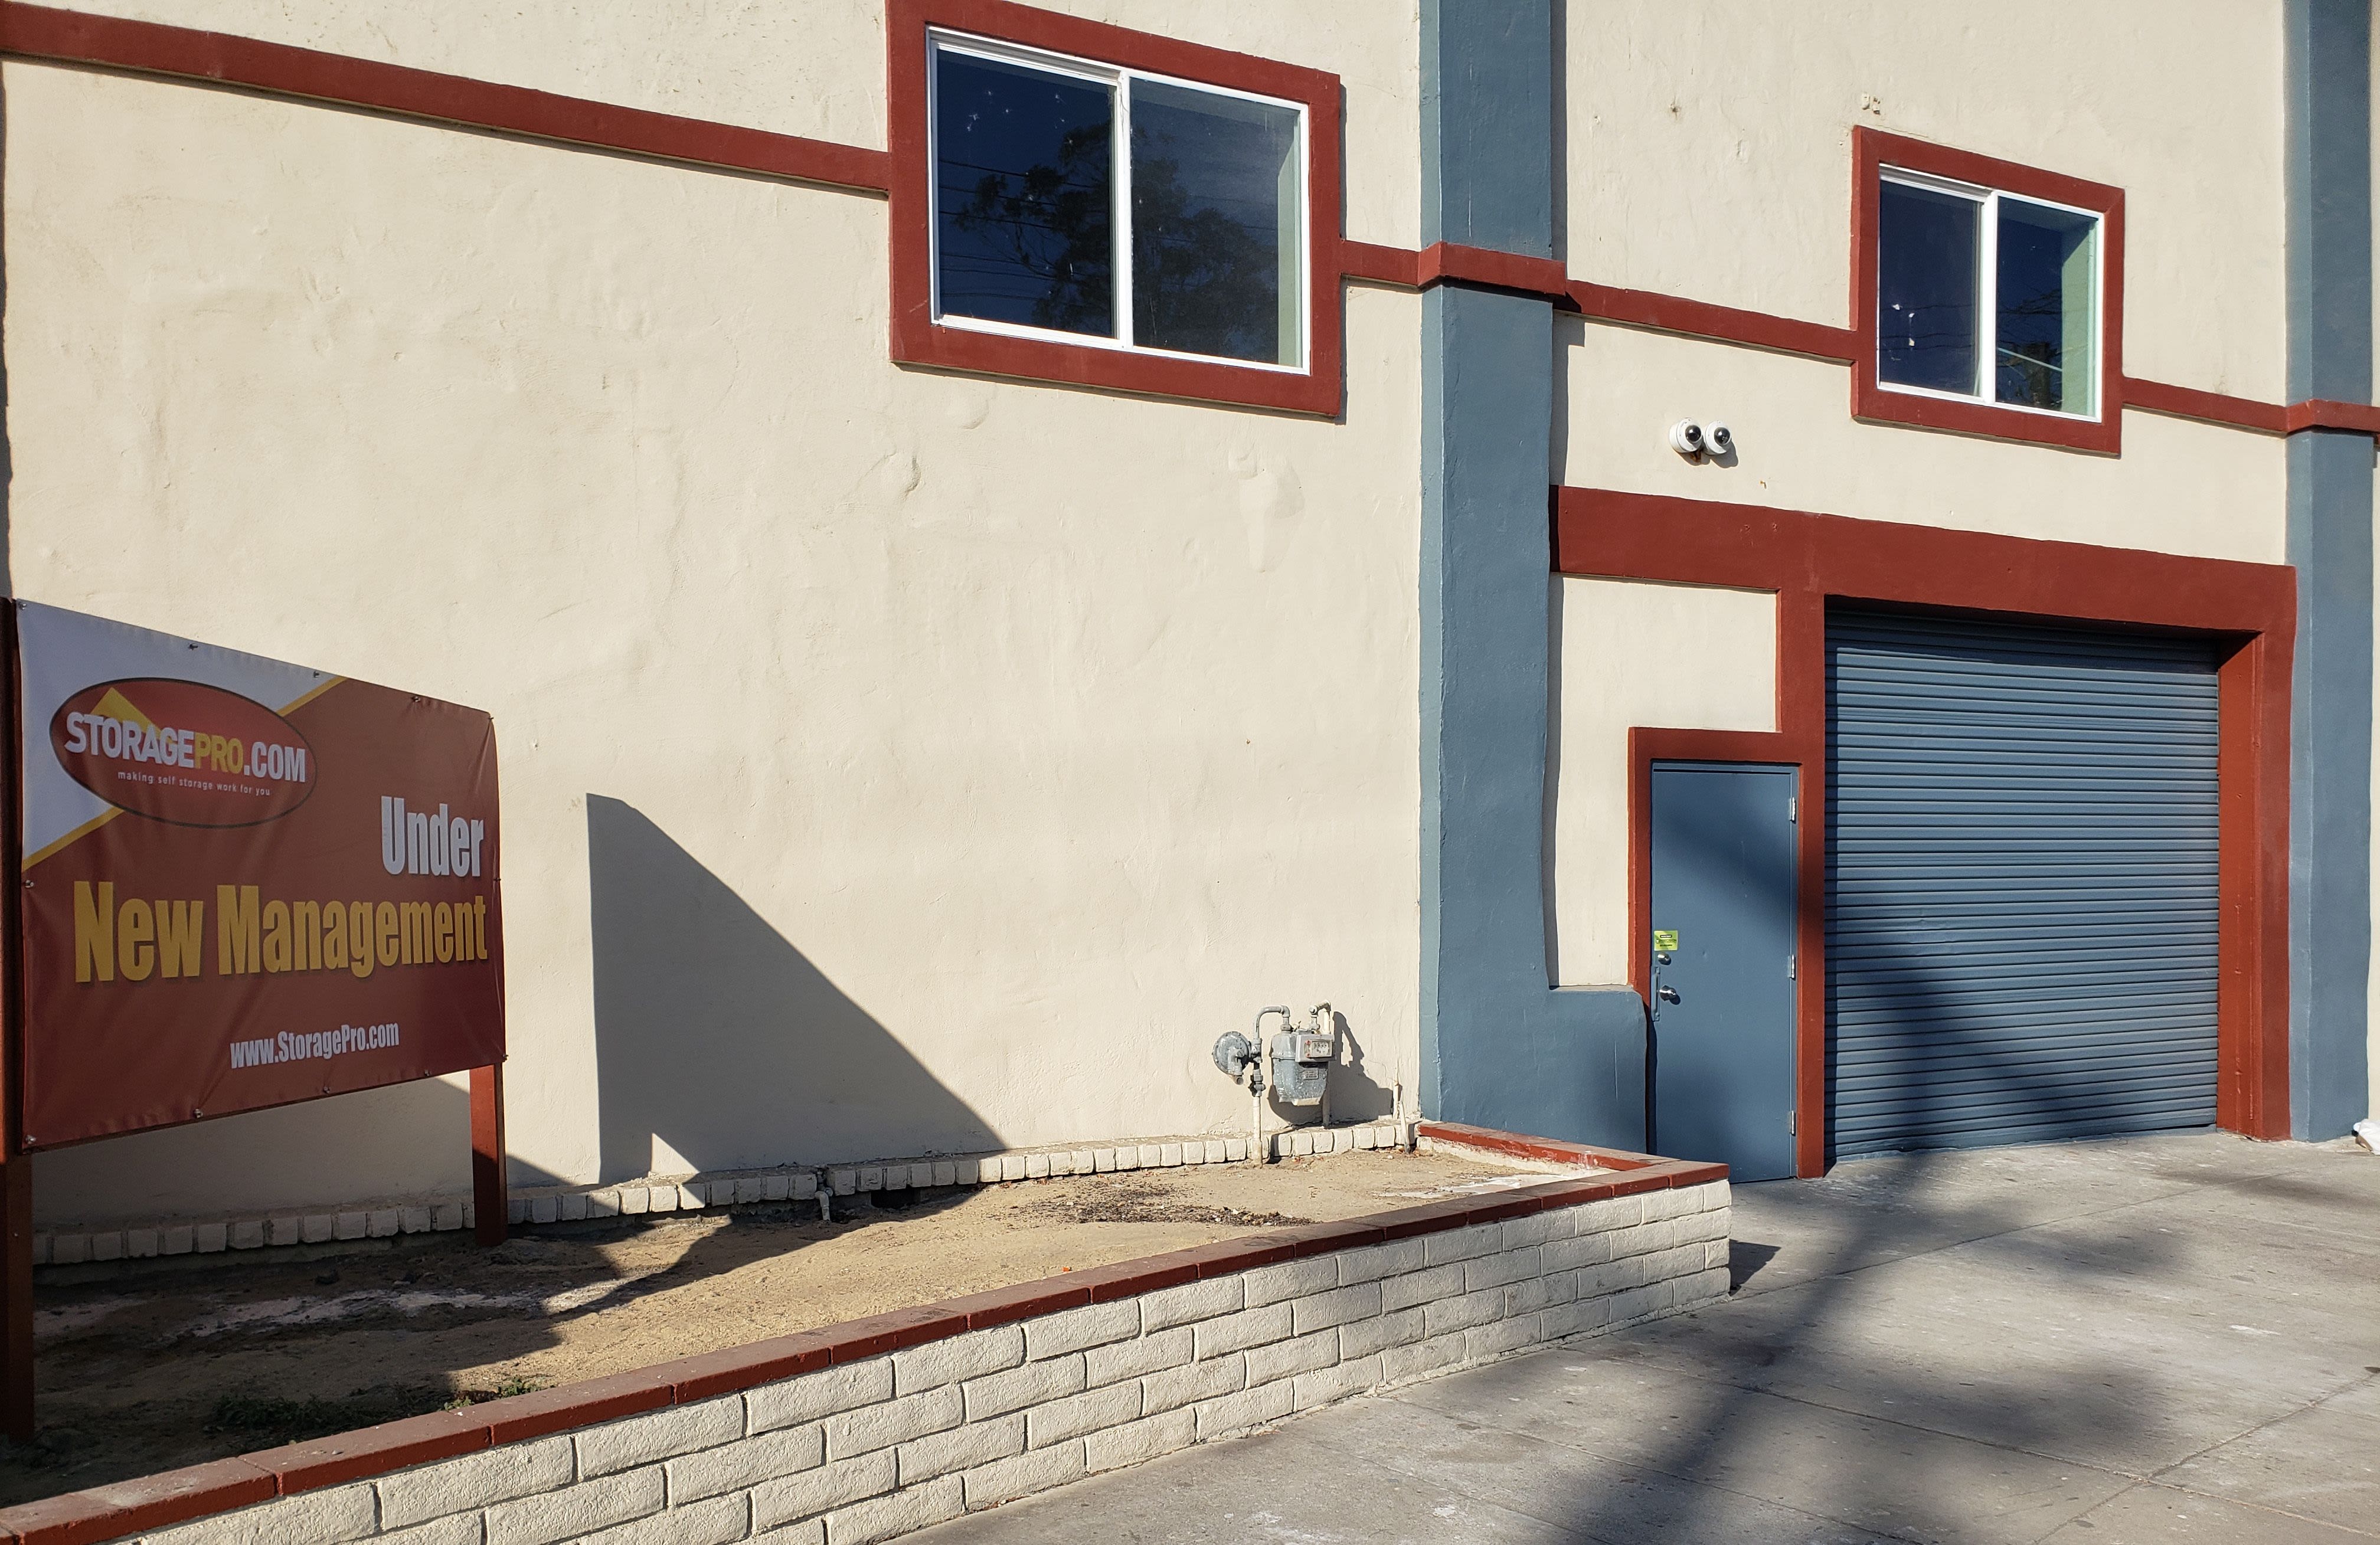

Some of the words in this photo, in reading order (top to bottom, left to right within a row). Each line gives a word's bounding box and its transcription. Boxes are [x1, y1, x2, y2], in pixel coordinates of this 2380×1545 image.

[65, 712, 306, 783] STORAGEPRO.COM
[118, 771, 154, 784] making
[158, 775, 176, 785] self
[179, 778, 213, 790] storage
[217, 783, 237, 793] work
[240, 784, 252, 794] for
[256, 787, 270, 796] you
[381, 796, 486, 877] Under
[73, 880, 204, 983] New
[216, 884, 488, 978] Management
[230, 1022, 400, 1069] www.StoragePro.com
